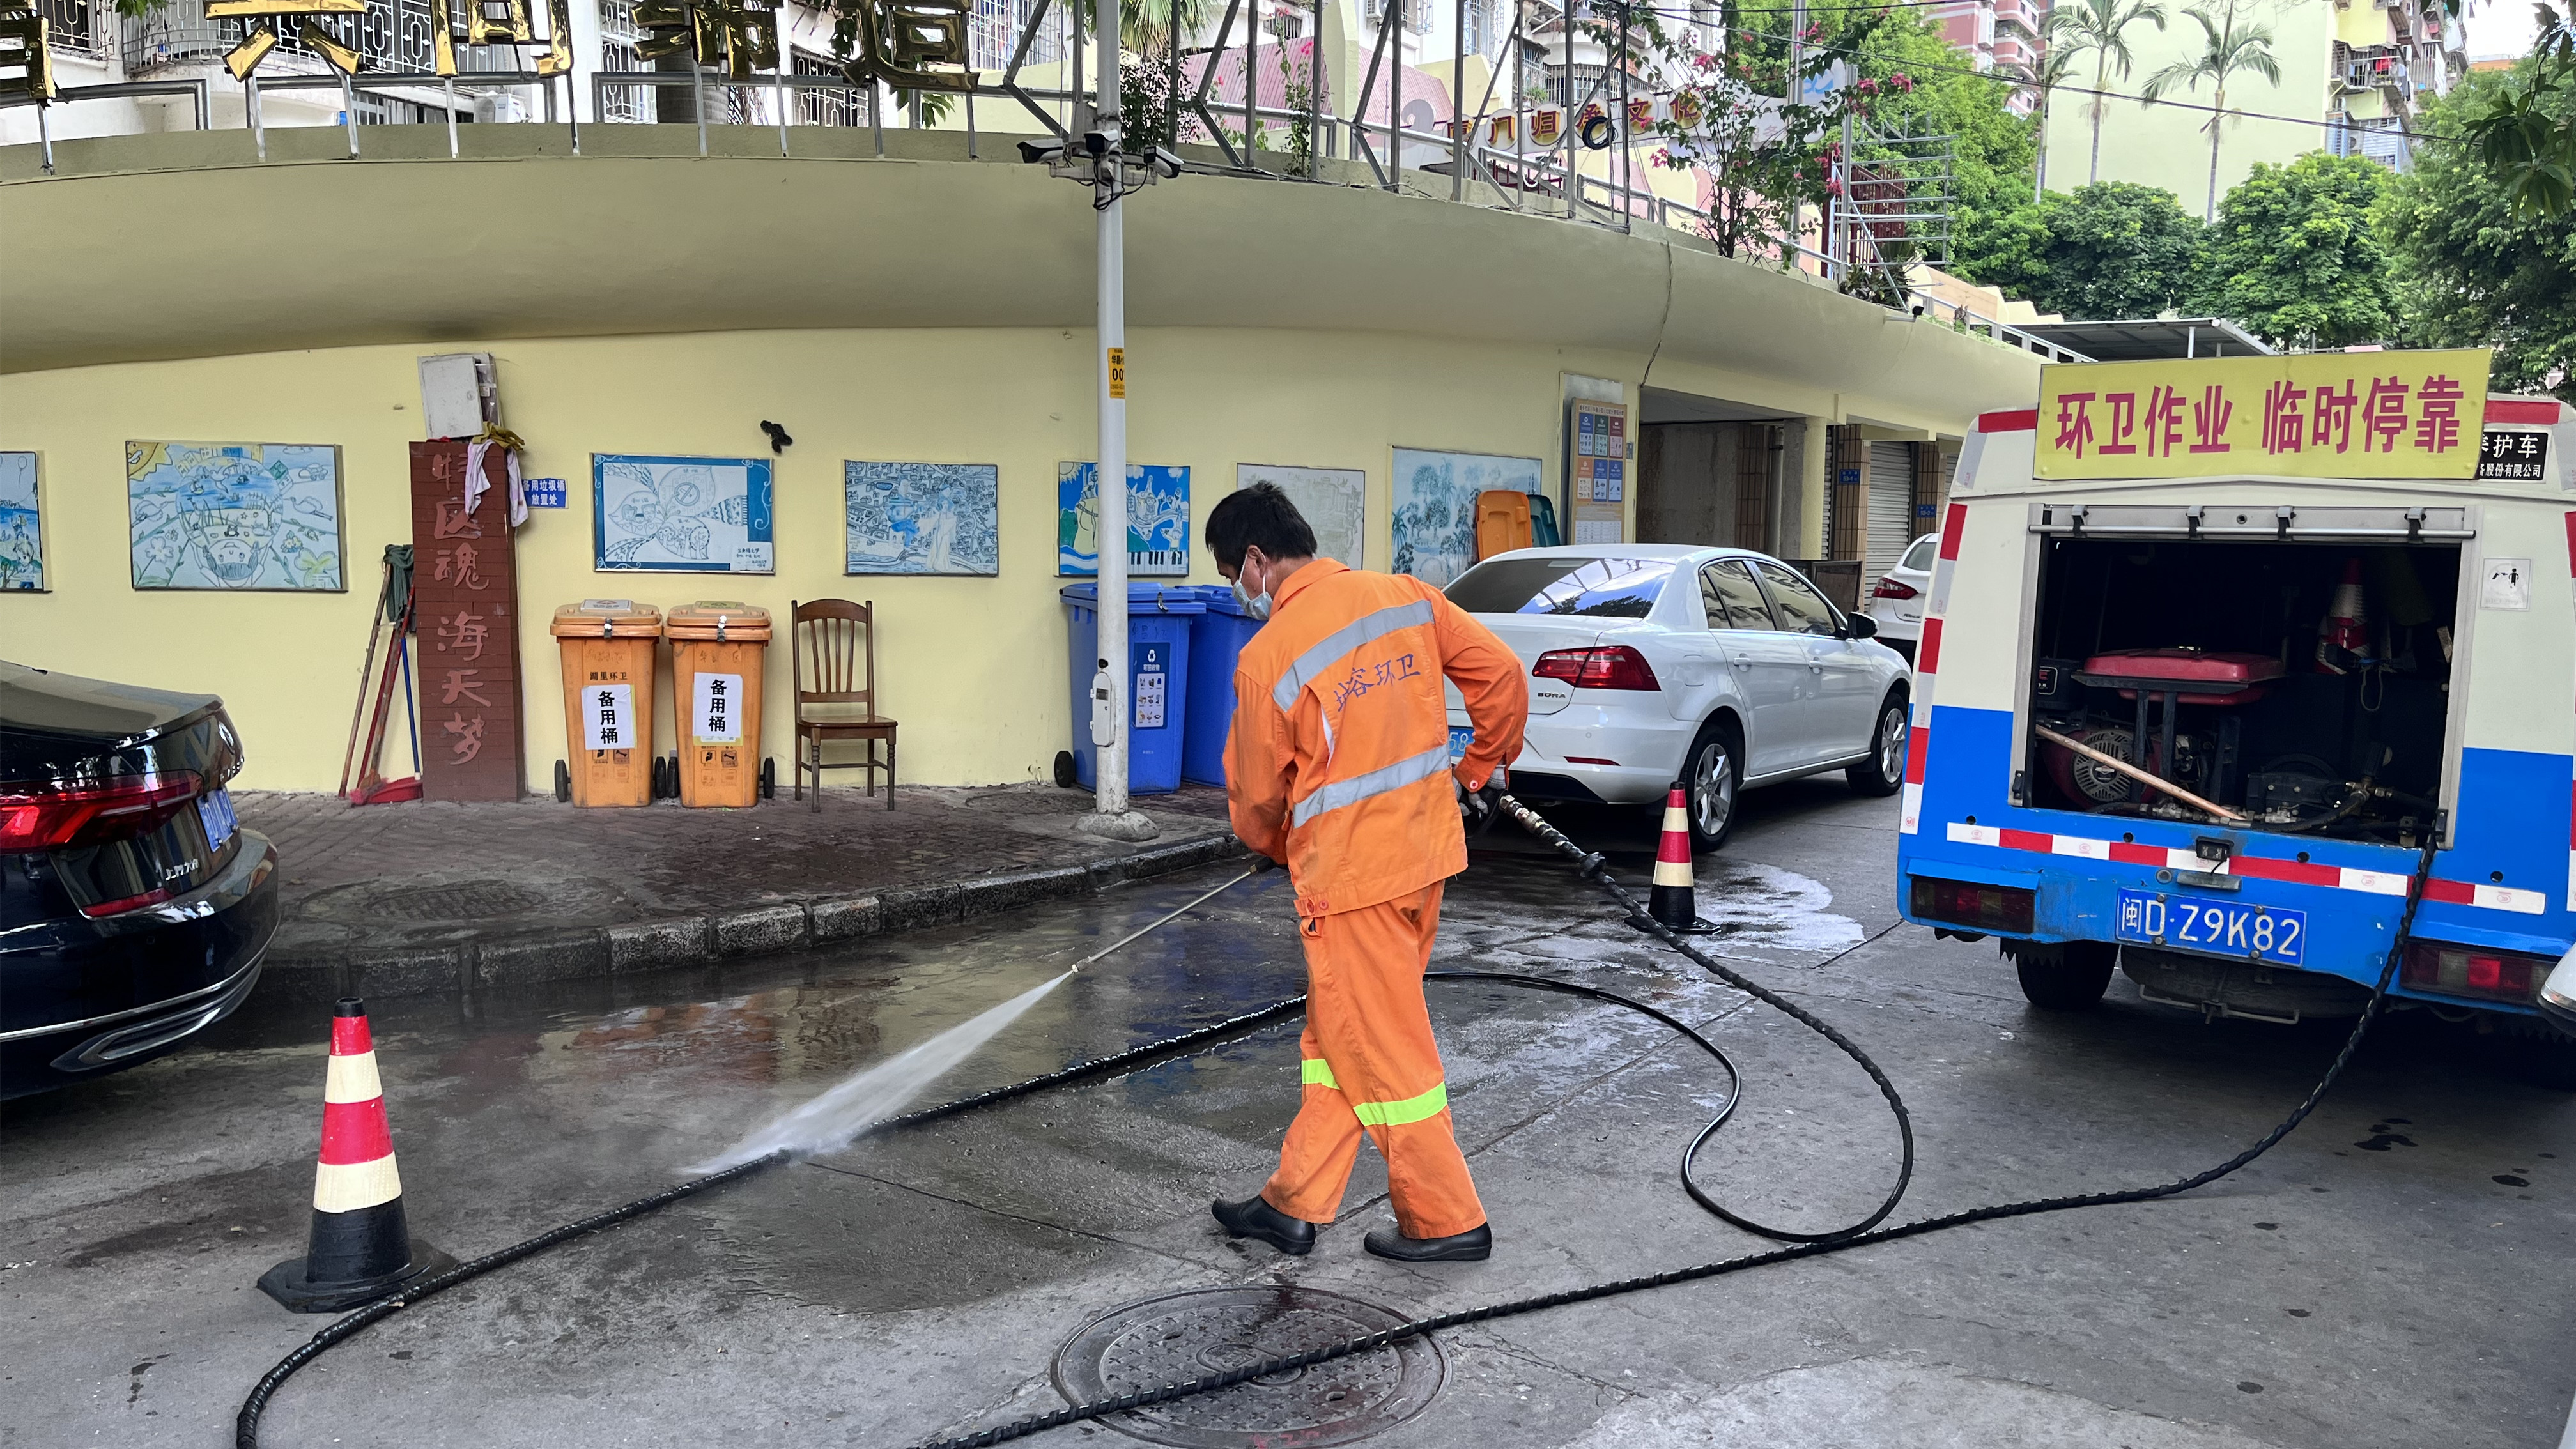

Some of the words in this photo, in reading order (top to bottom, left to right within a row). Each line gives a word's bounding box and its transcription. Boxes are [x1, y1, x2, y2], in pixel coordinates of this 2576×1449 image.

[2055, 385, 2233, 459] 环卫作业
[2261, 374, 2464, 456] 临时停靠
[523, 479, 566, 492] 备用垃圾桶
[531, 493, 557, 505] 放置处
[590, 671, 628, 681] 湖里环卫
[708, 679, 727, 732] 备用桶
[598, 691, 618, 744] 备用桶
[1449, 732, 1475, 751] 58
